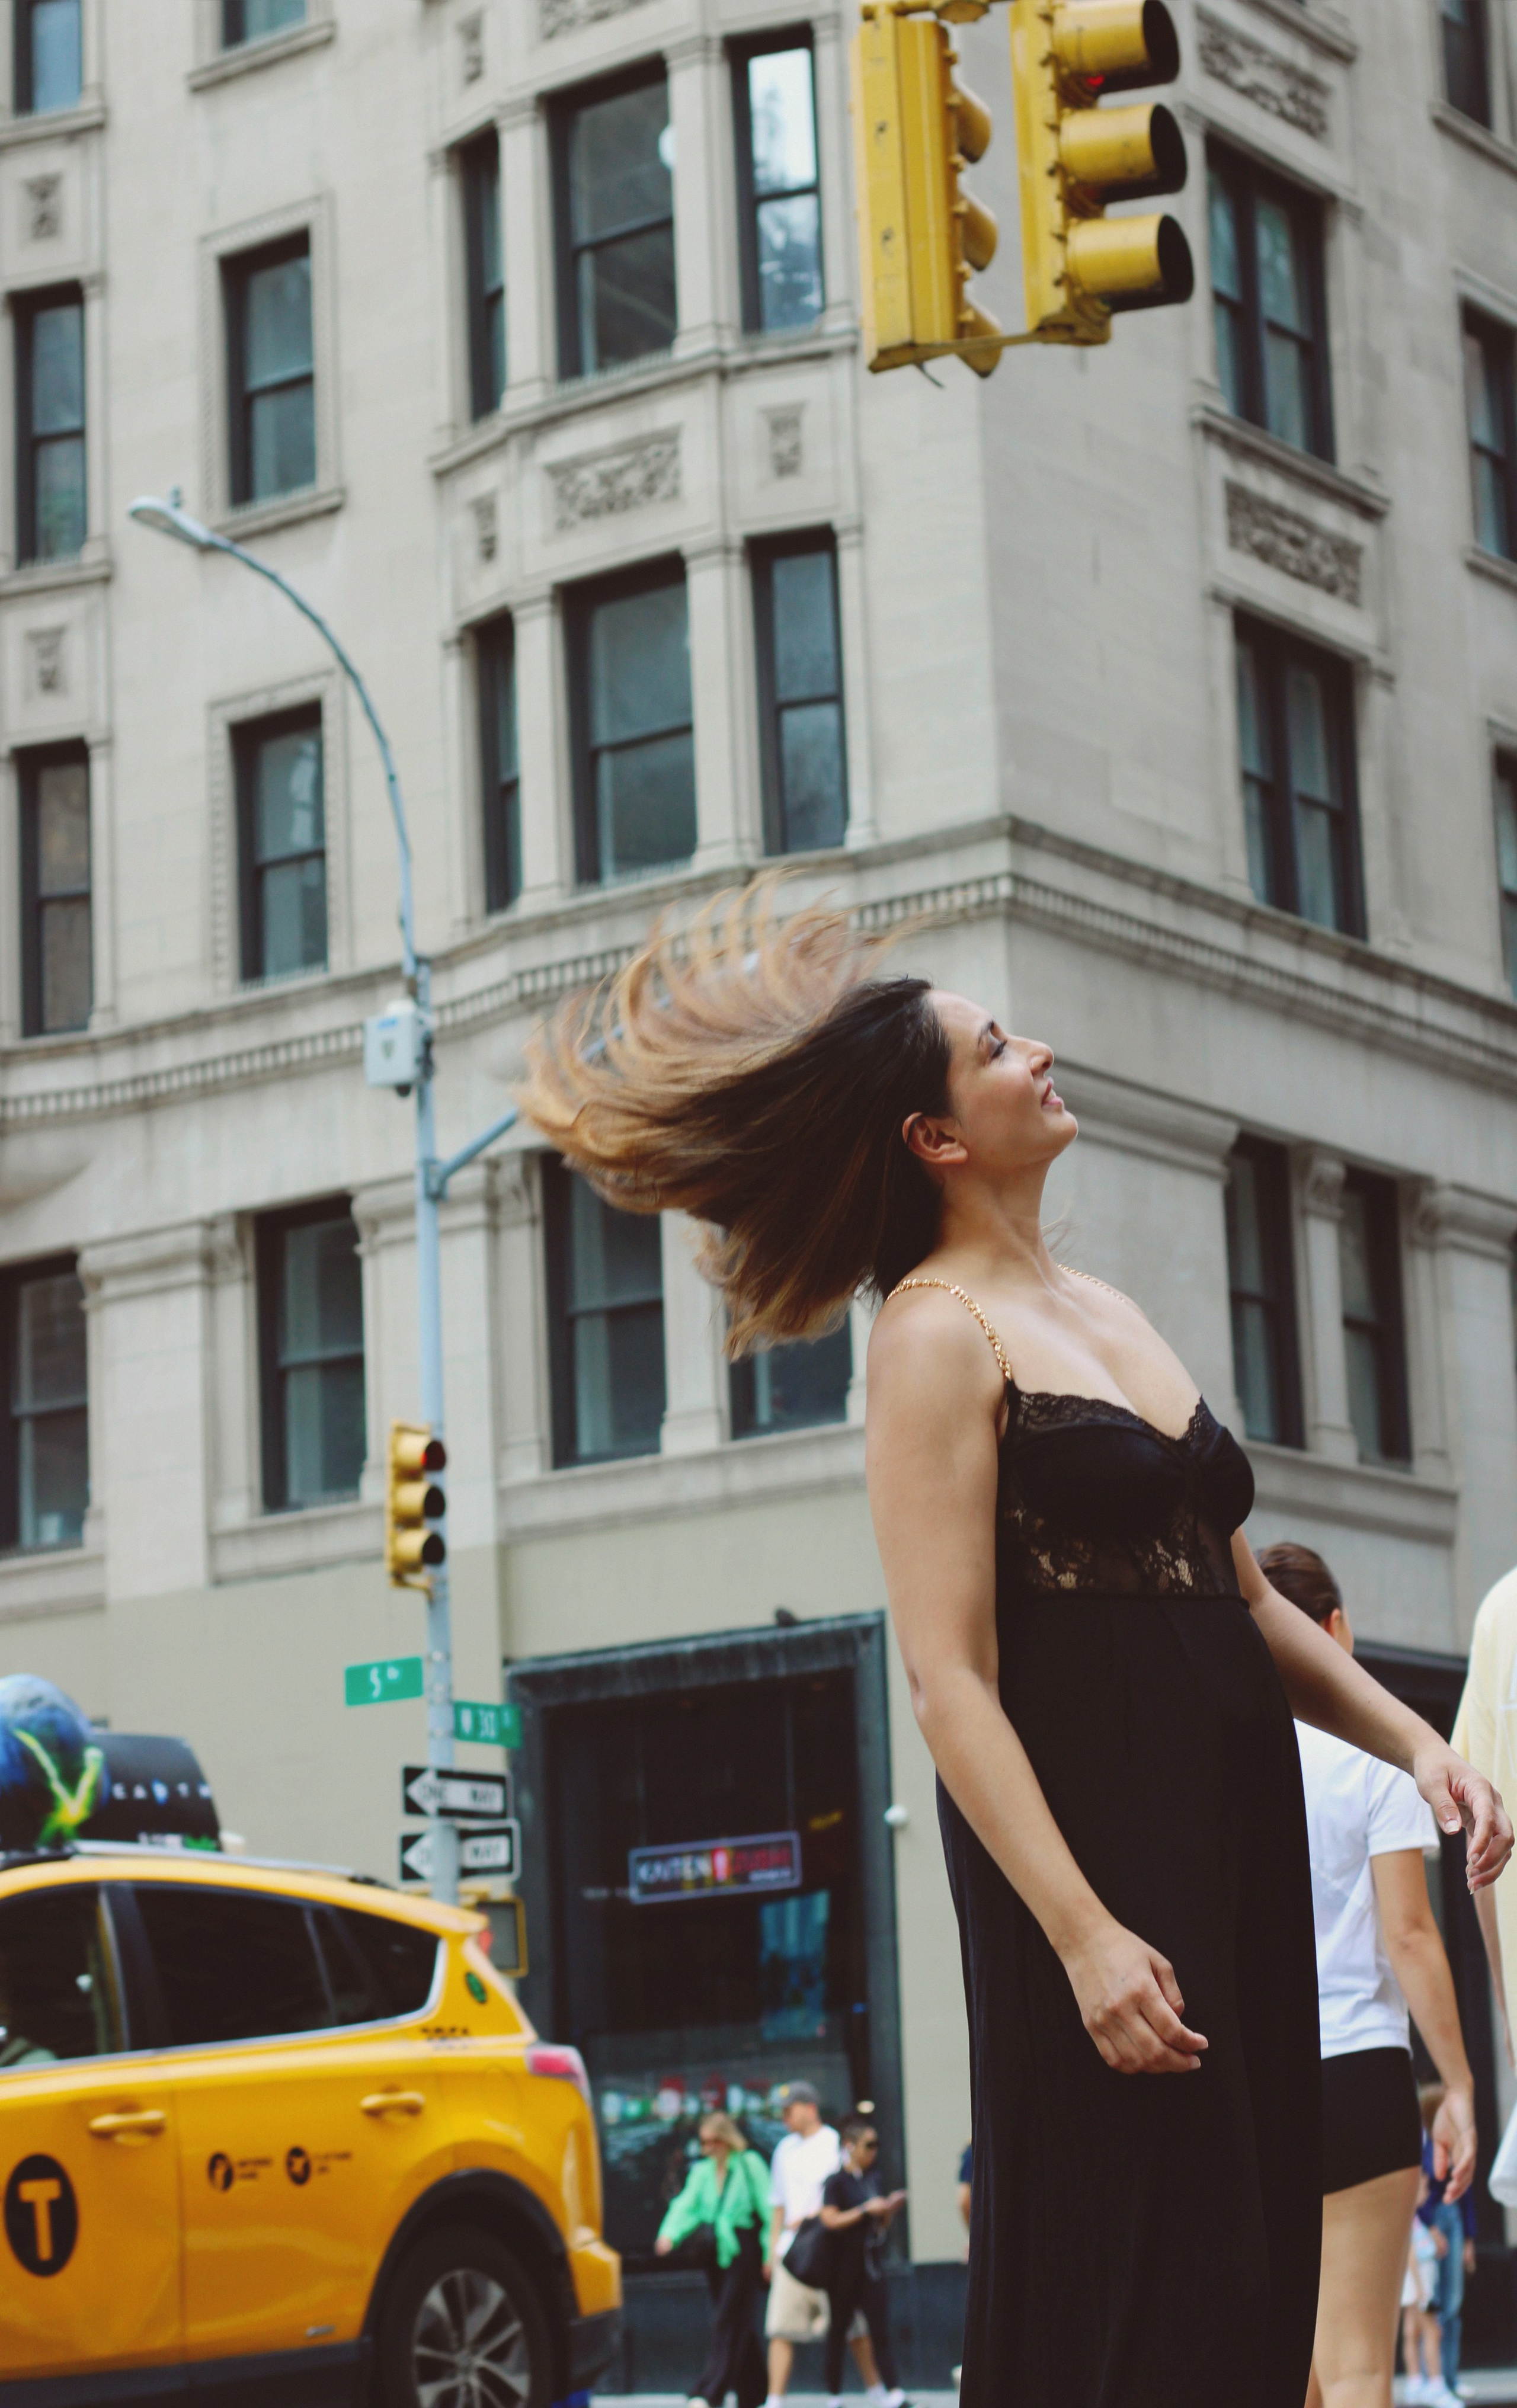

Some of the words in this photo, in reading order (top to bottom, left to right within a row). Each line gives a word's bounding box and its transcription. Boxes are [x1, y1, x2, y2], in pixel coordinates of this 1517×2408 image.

[370, 1666, 381, 1699] 5
[419, 1783, 447, 1802] ONE
[471, 1788, 497, 1805] WAY
[471, 1844, 501, 1861] WAY
[18, 2178, 61, 2262] T
